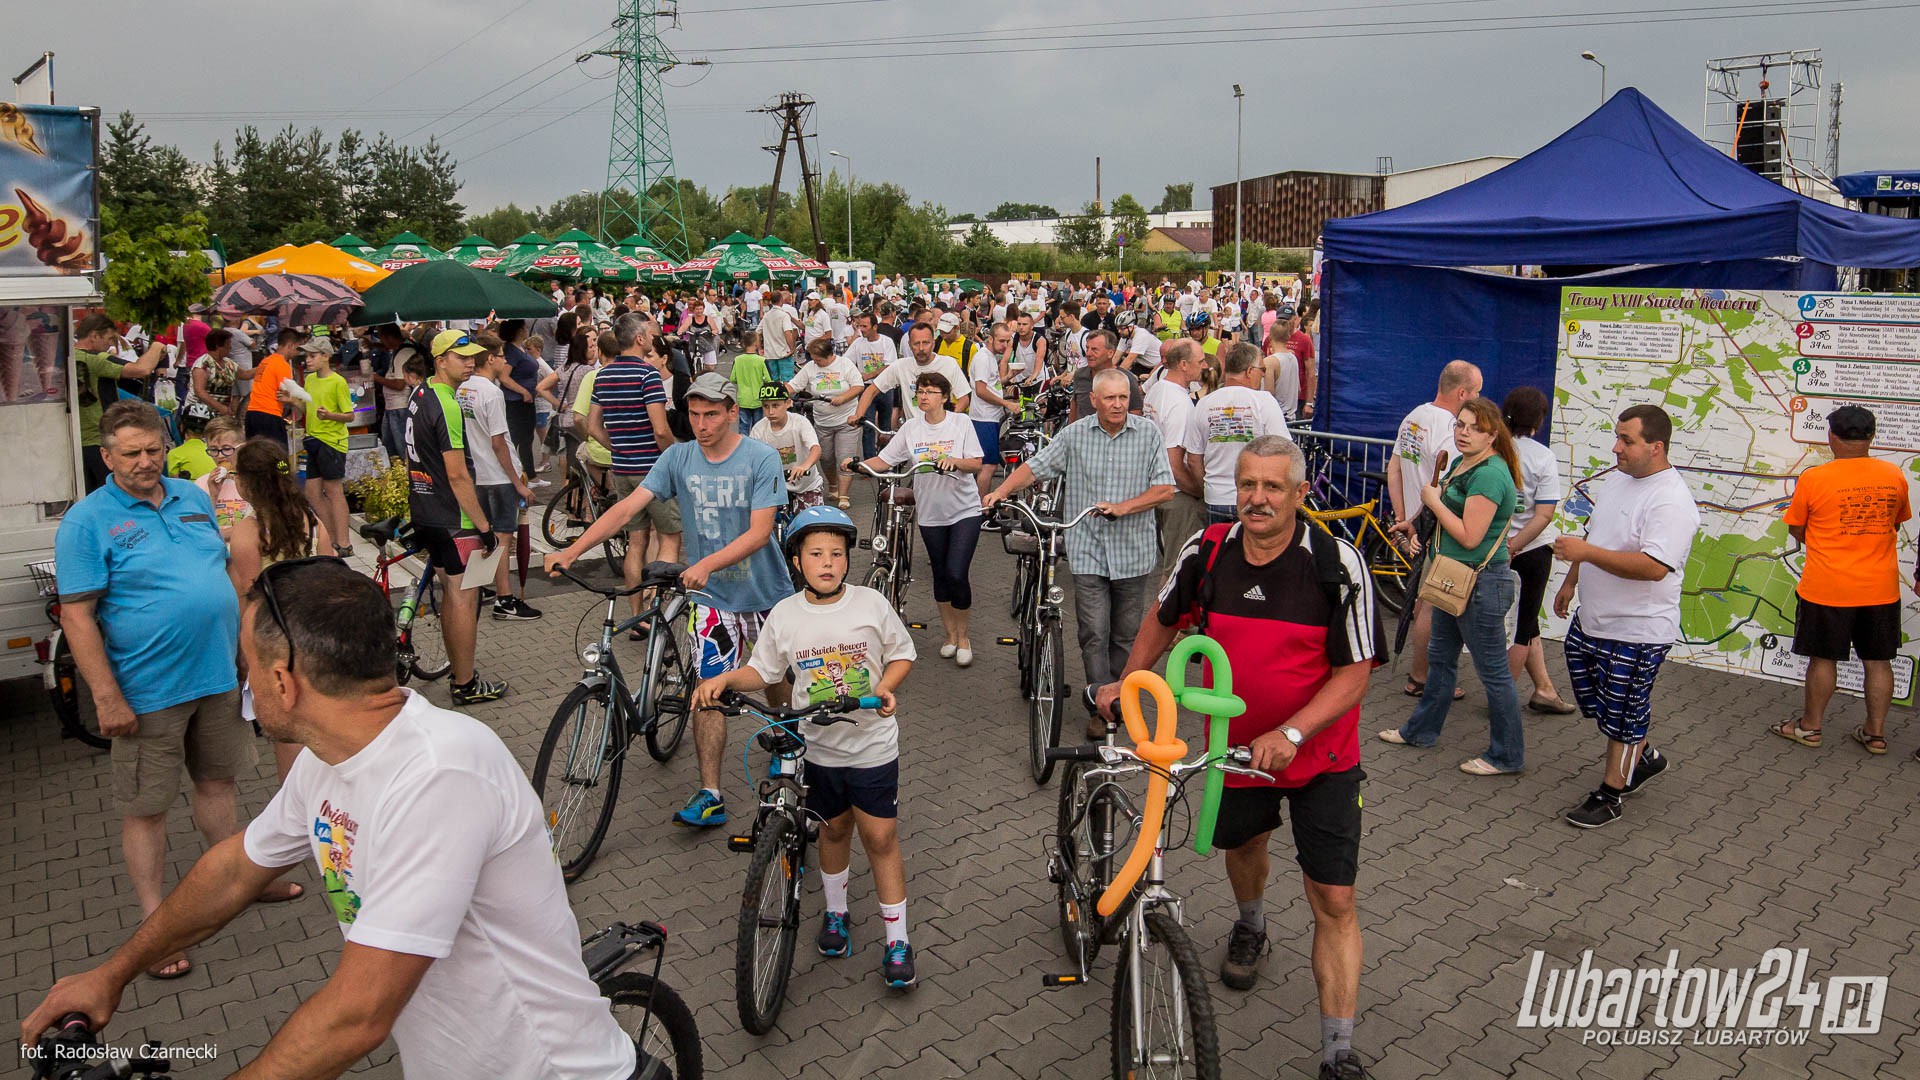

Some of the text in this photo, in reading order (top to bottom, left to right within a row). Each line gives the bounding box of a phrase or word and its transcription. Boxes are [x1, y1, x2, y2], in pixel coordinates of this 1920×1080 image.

[1567, 292, 1607, 311] Trasy
[1610, 293, 1644, 309] XXIII
[1698, 295, 1759, 312] Roweru
[1803, 298, 1811, 309] 1.
[1568, 322, 1577, 332] 6.
[1799, 324, 1811, 336] 2.
[1796, 360, 1807, 372] 3.
[760, 386, 779, 397] BOY
[1793, 398, 1804, 410] 5.
[1802, 422, 1814, 430] 36
[685, 474, 750, 508] SERI
[838, 641, 867, 653] Roweru
[1764, 635, 1774, 648] 4.
[1771, 658, 1783, 667] 58
